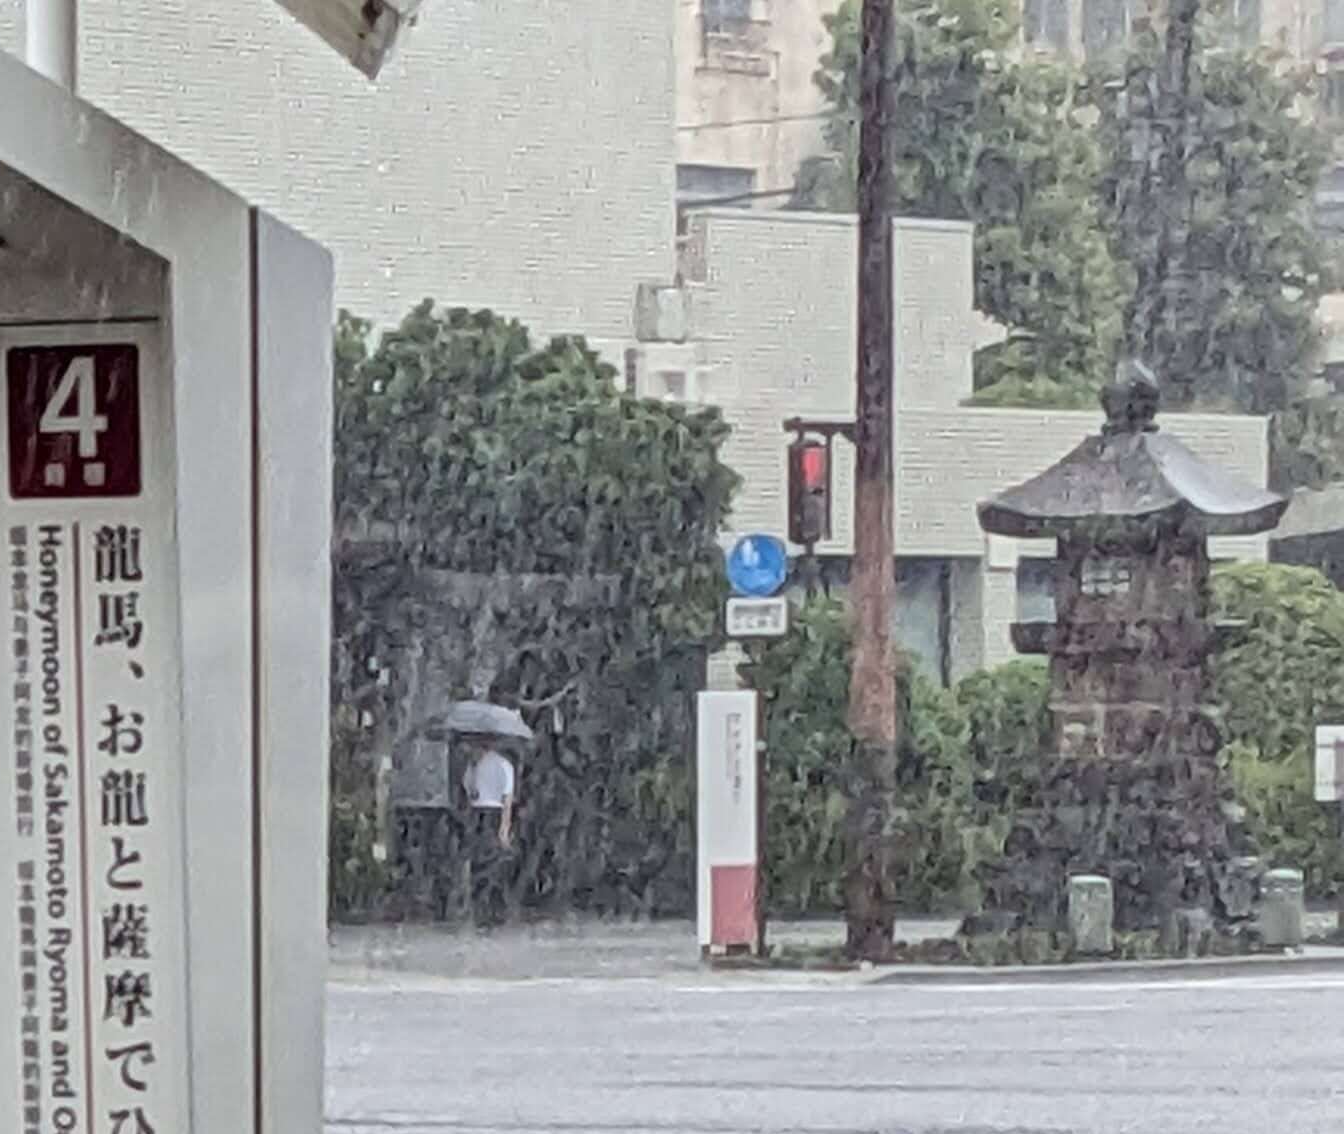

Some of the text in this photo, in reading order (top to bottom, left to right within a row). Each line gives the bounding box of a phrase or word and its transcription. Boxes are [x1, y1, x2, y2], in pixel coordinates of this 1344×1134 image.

[40, 355, 108, 458] 4
[34, 524, 63, 716] Honeymoon
[43, 720, 69, 757] of
[42, 763, 71, 920] Sakamoto
[43, 927, 72, 1033] Ryoma
[49, 1039, 77, 1100] and
